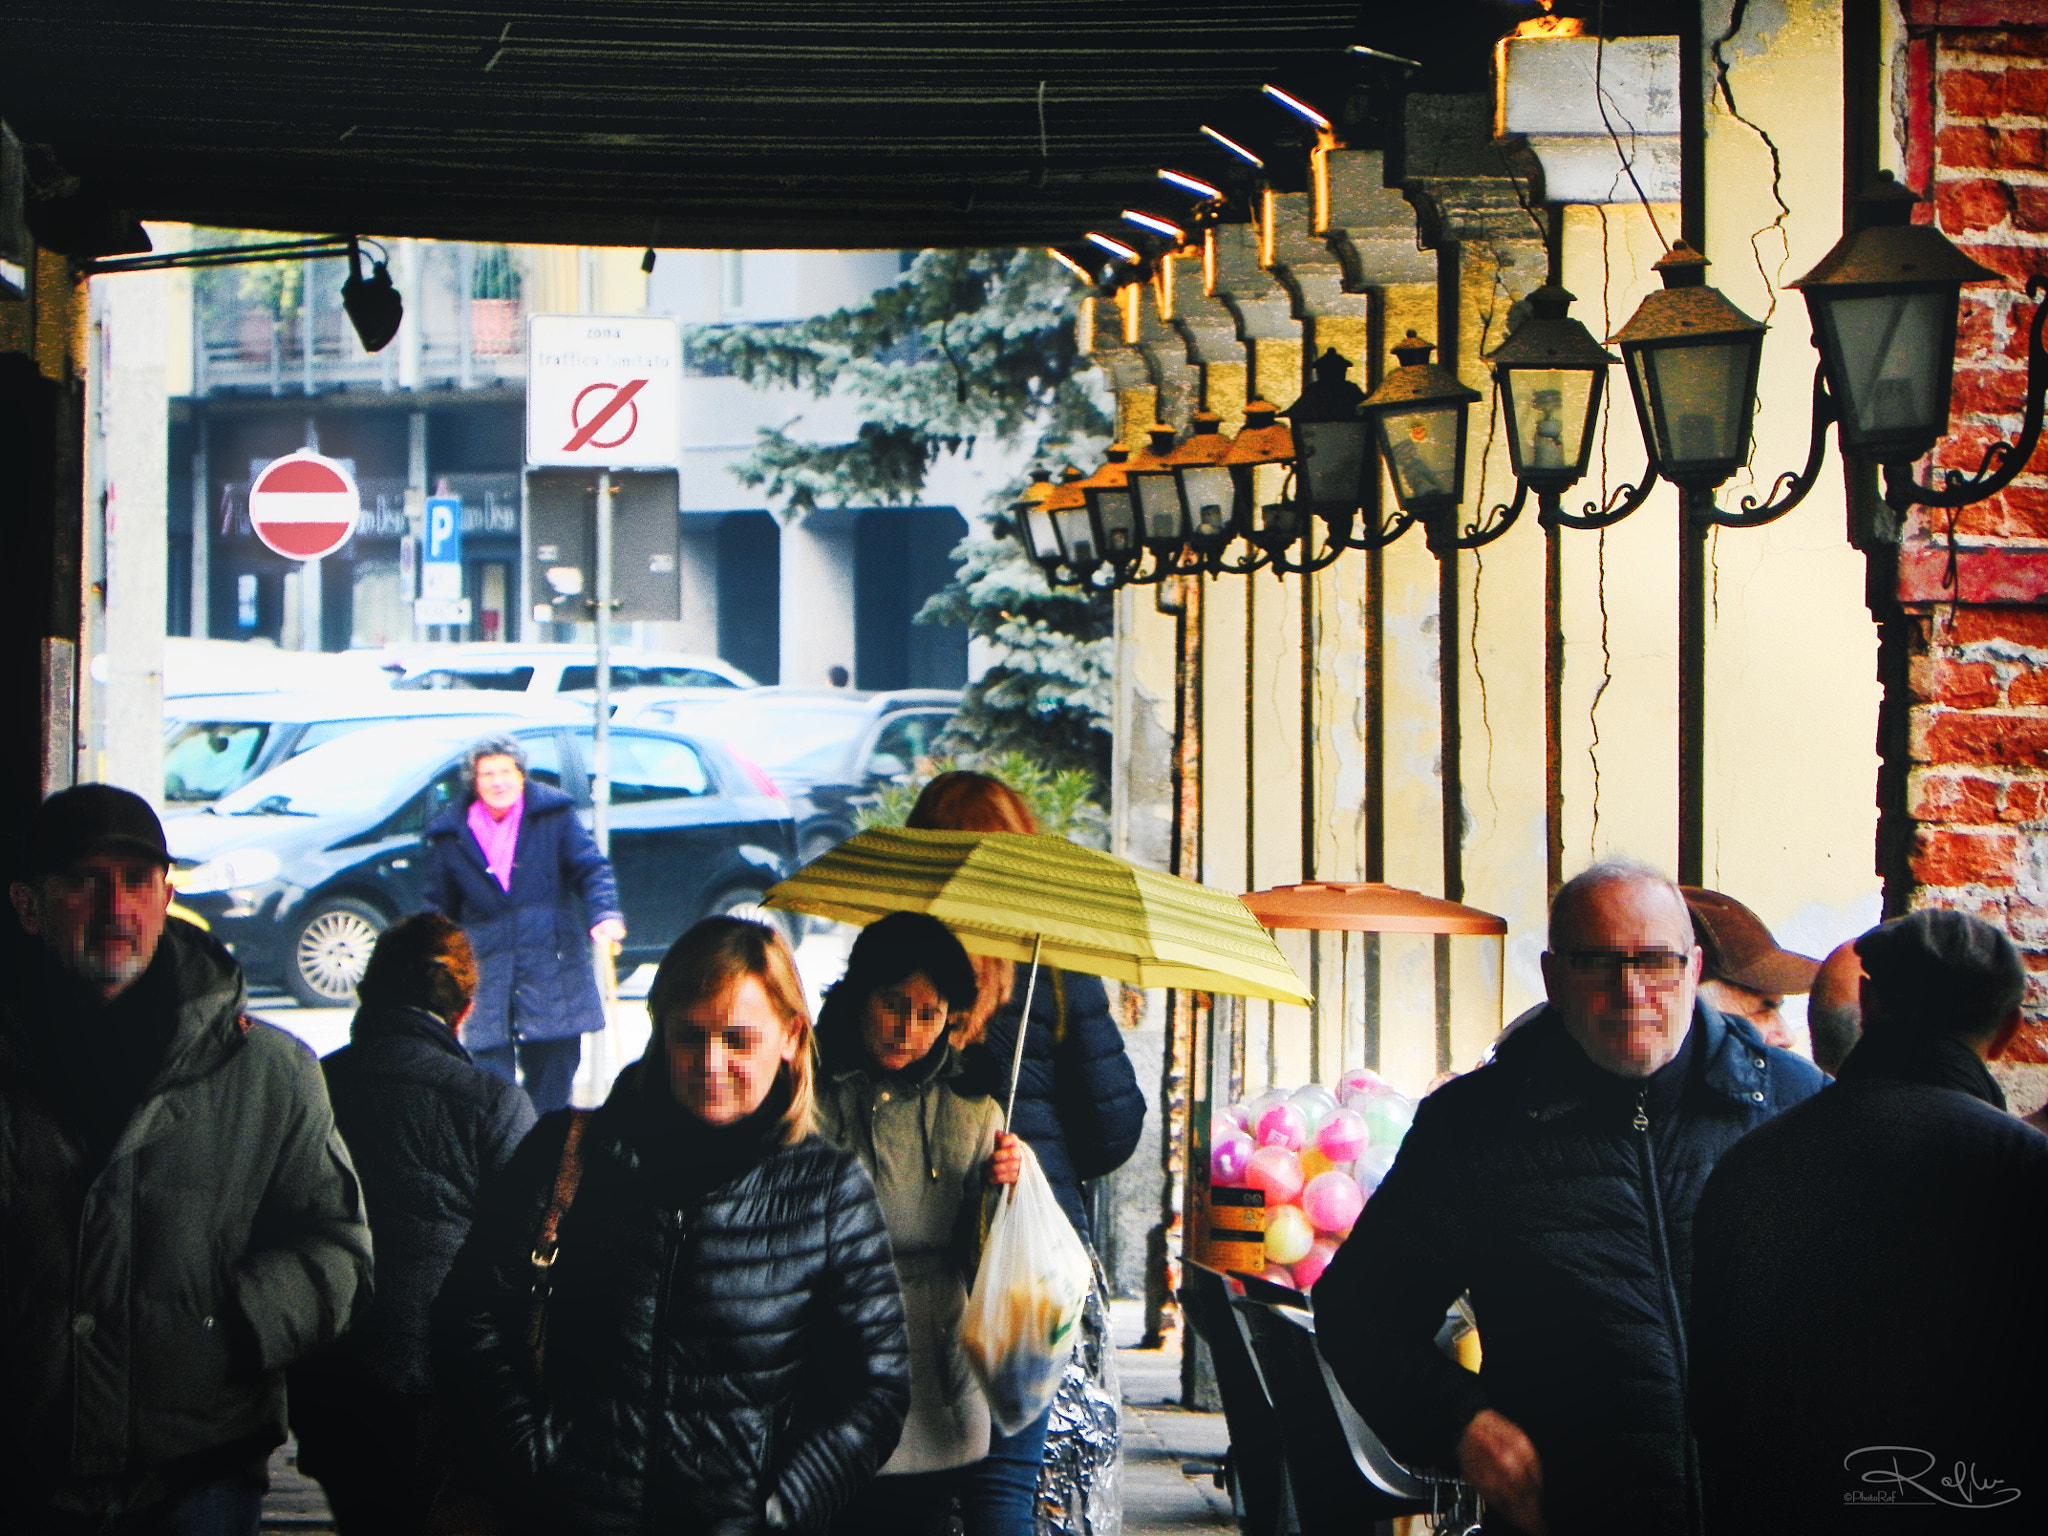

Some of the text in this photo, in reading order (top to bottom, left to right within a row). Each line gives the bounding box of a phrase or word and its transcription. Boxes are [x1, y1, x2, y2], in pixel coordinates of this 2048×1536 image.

[586, 328, 621, 339] zona
[538, 350, 670, 368] traffico limitato
[431, 505, 453, 557] P
